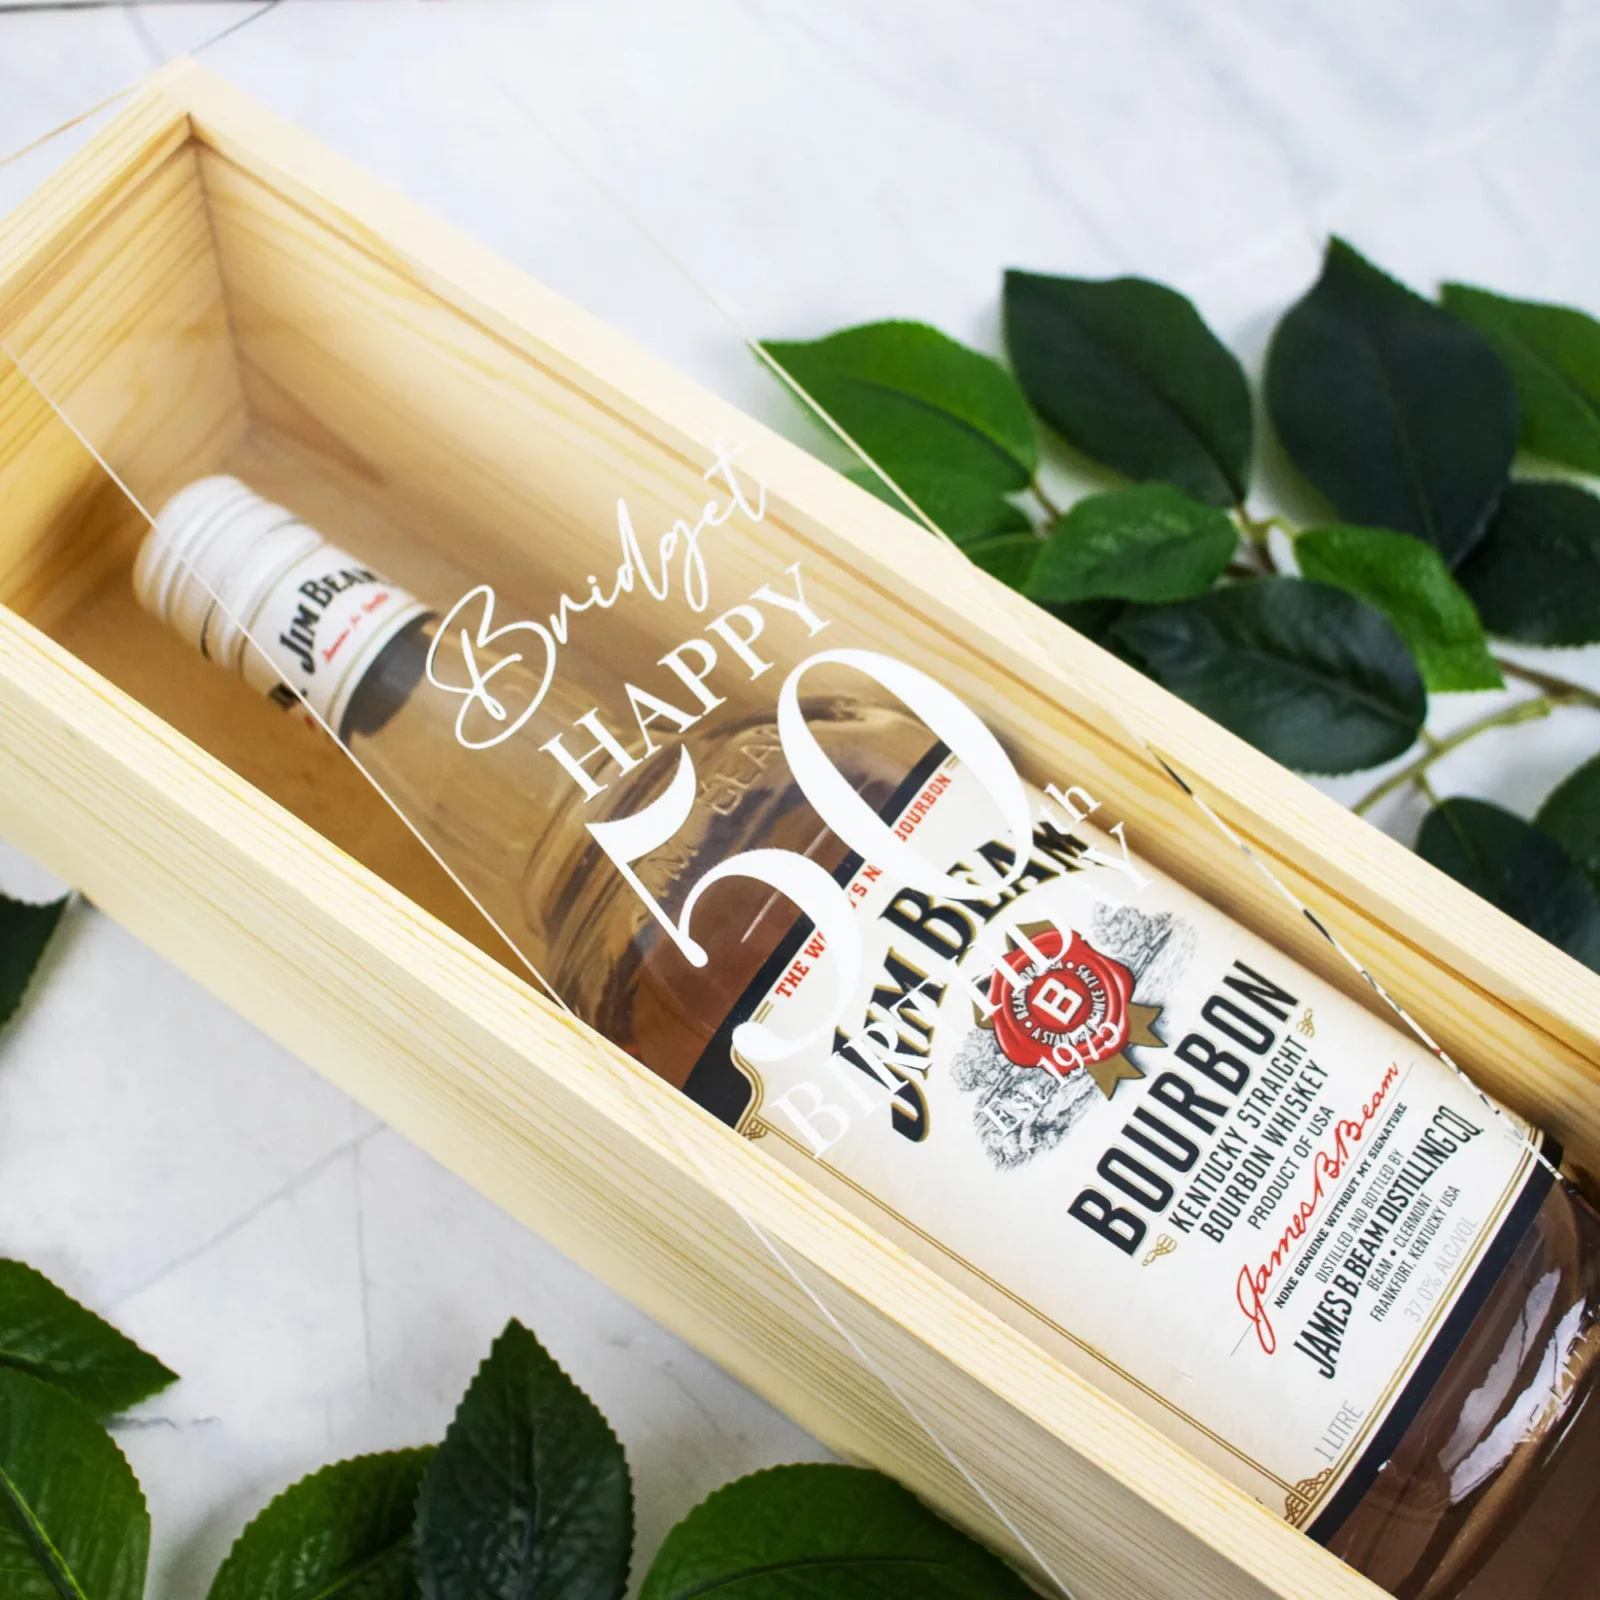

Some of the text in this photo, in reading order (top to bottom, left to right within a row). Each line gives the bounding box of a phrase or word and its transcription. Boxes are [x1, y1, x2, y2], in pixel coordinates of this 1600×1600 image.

[279, 603, 320, 675] JIM
[426, 438, 766, 749] Bridget
[537, 561, 832, 802] HAPPY
[775, 960, 810, 998] THE
[1031, 977, 1084, 1025] B
[1075, 964, 1100, 988] 1795
[982, 1020, 1121, 1137] Est 1975
[1066, 960, 1299, 1257] BOURBON
[1168, 1034, 1308, 1234] KENTUCKY STRAIGHT
[1200, 1059, 1329, 1244] BOURBON WHISKEY
[1236, 1199, 1314, 1355] James
[1334, 1061, 1400, 1160] Beam
[1247, 1105, 1335, 1230] PRODUCT OF USA
[1274, 1102, 1408, 1309] NONE GENUINE WITHOUT MY SIGNATURE
[1293, 1290, 1353, 1380] JAMES
[1343, 1221, 1389, 1281] BEAM
[1383, 1128, 1458, 1229] DISTILLING
[1432, 1104, 1485, 1144] CO.
[1315, 1148, 1405, 1284] DISTILLED AND BOTTLED BY
[1366, 1191, 1434, 1292] BEAM CLERMONT
[1404, 1216, 1480, 1323] 37.0% ALC/VOL
[1407, 1209, 1447, 1261] KENTUCKY
[1442, 1184, 1461, 1210] USA
[1321, 1398, 1365, 1454] LITRE
